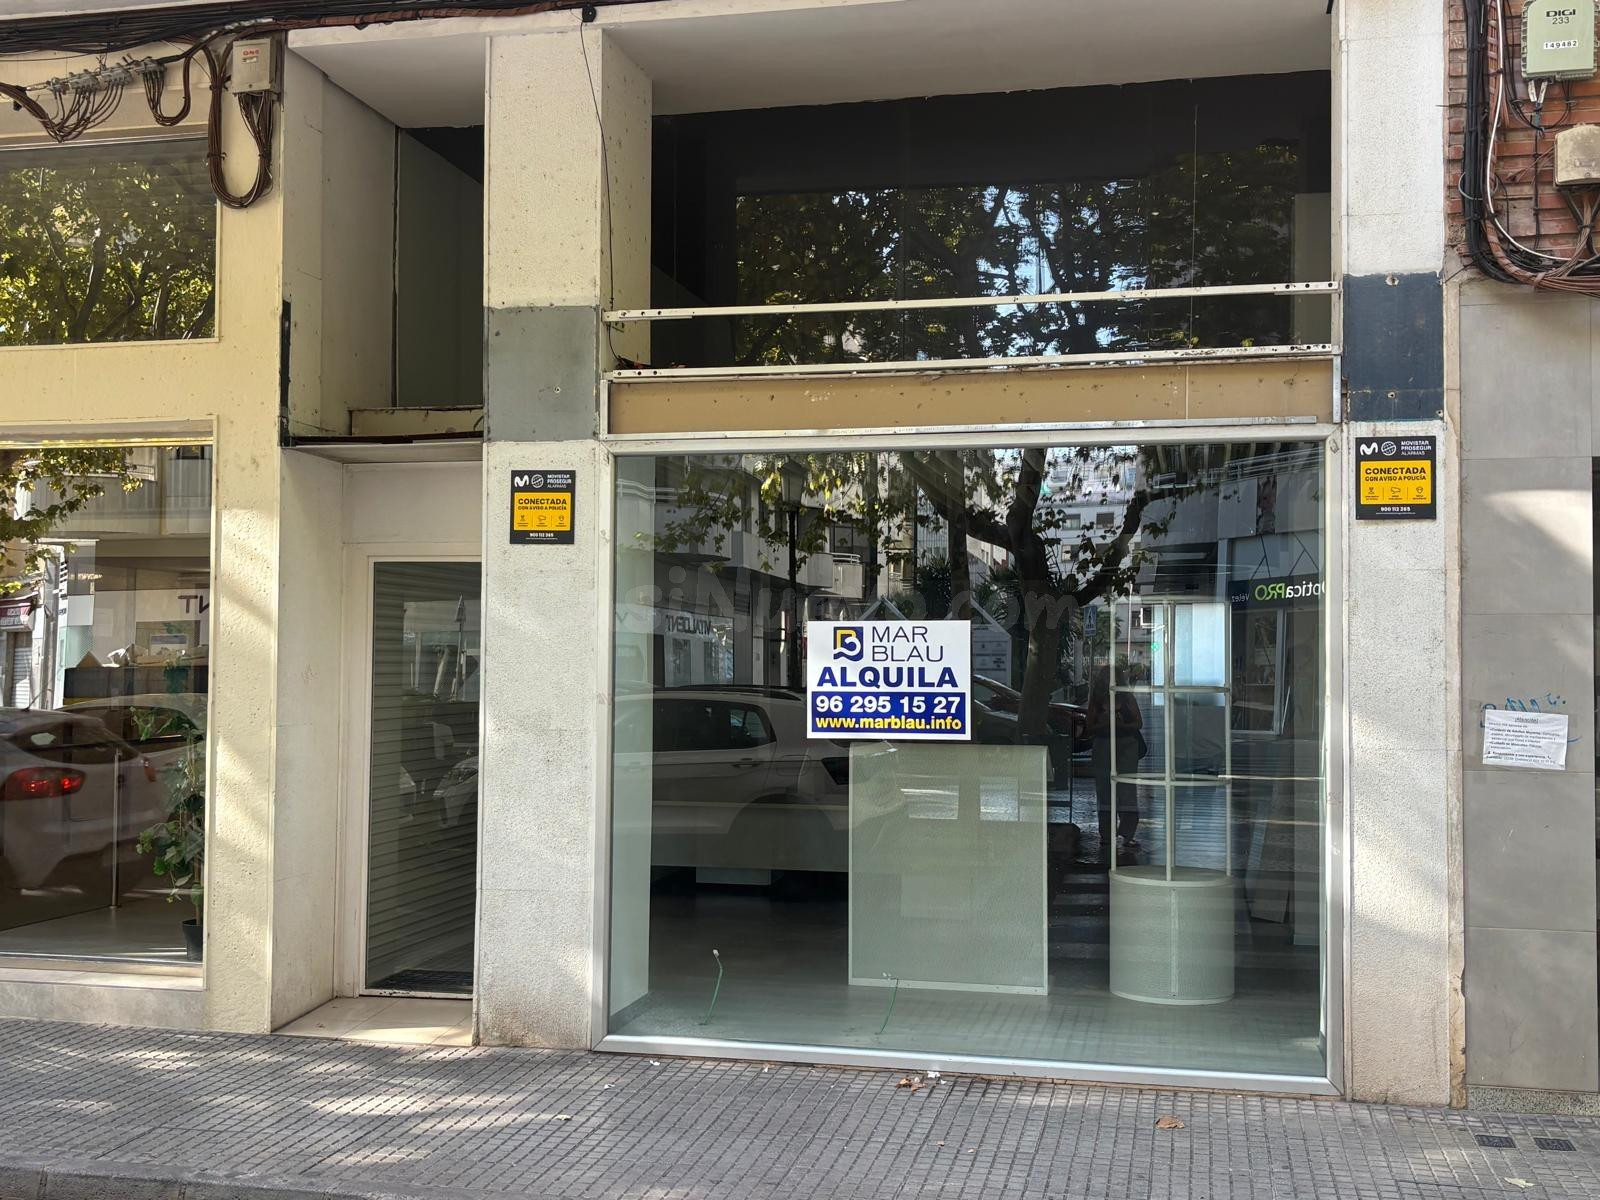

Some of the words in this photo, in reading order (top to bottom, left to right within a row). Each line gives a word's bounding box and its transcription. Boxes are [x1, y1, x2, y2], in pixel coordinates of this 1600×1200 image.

[1545, 8, 1577, 17] DIGI
[1552, 16, 1570, 25] 233
[1545, 40, 1577, 48] 149482
[1365, 467, 1427, 475] CONECTADA
[872, 626, 928, 643] MAR
[872, 645, 944, 662] BLAU
[816, 666, 959, 689] ALQUILA
[816, 695, 843, 713] 96
[850, 695, 891, 713] 295
[899, 696, 926, 714] 15
[933, 696, 961, 714] 27
[815, 715, 962, 730] www.marblau.info
